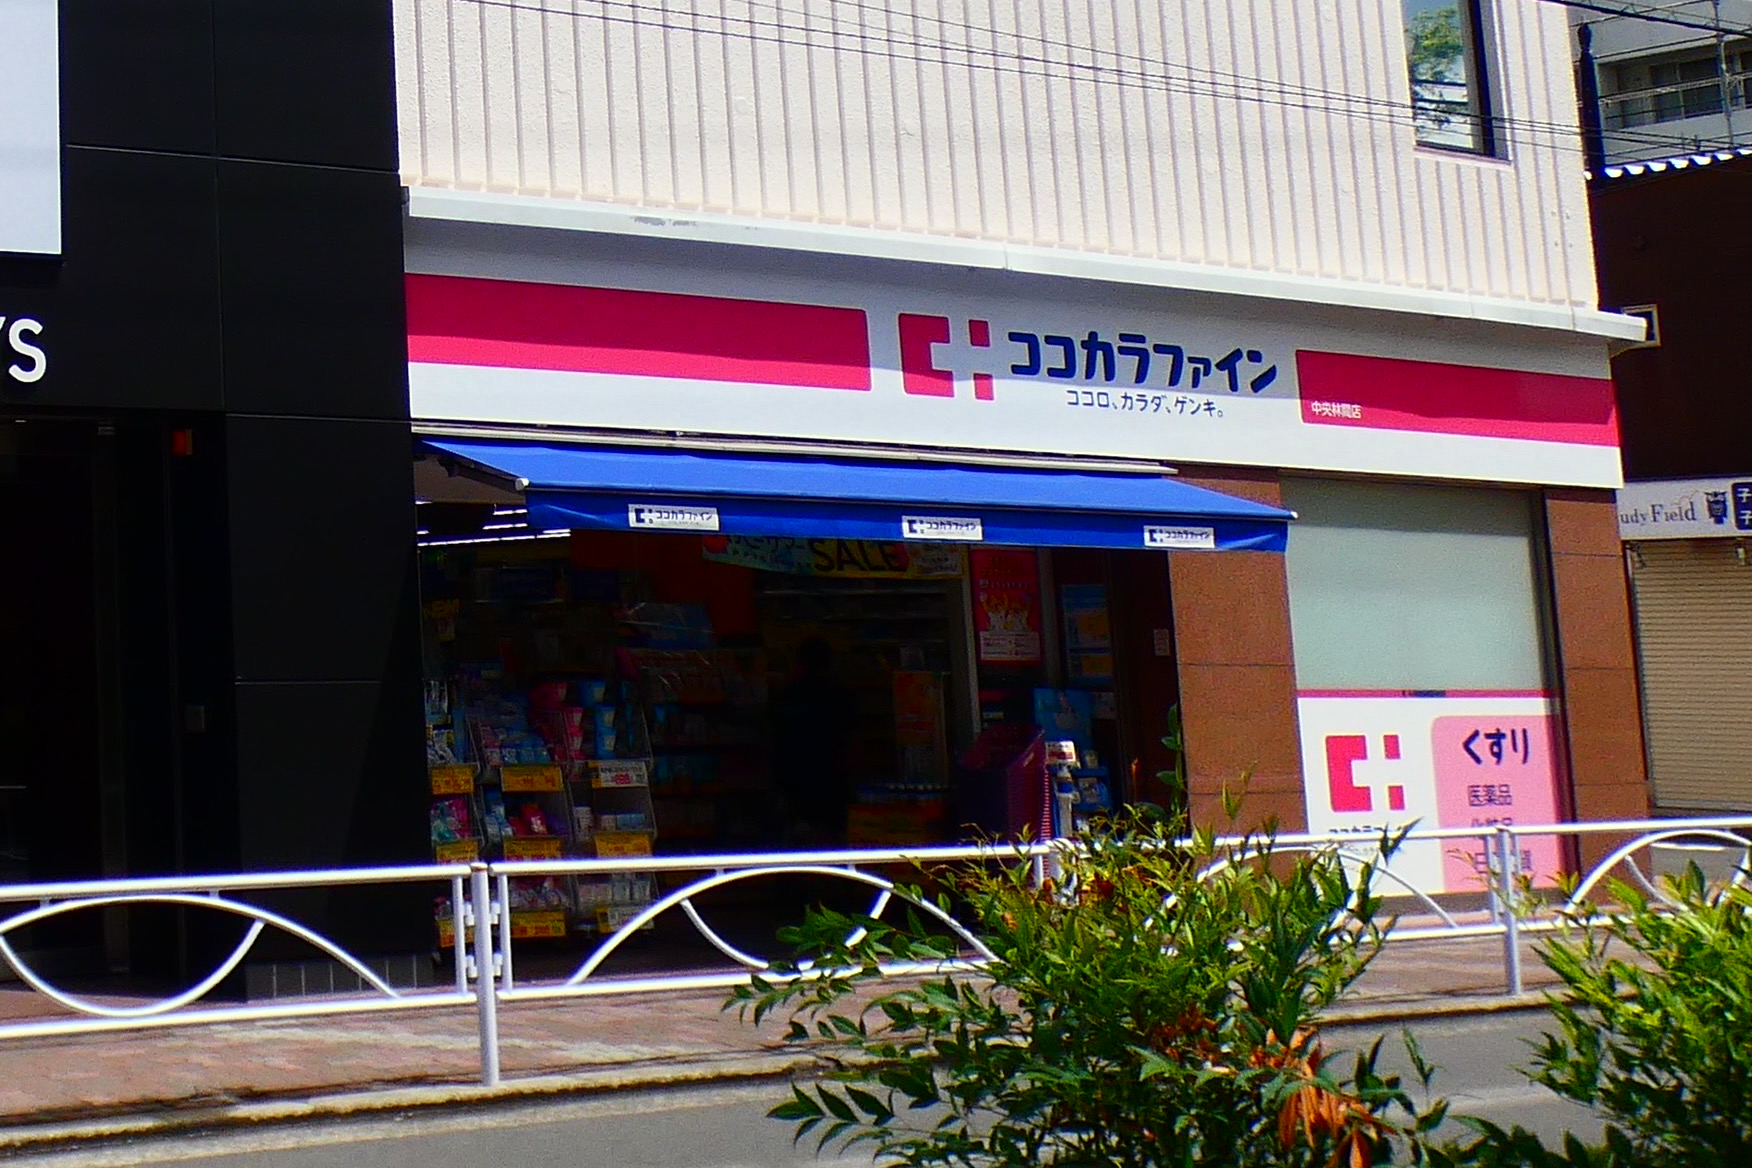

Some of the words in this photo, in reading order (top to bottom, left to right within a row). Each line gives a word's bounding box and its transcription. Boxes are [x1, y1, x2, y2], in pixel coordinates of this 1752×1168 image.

[1007, 331, 1277, 393] ココカラファイン
[1065, 389, 1224, 418] ココロ、カラダ、ゲンキ。
[1619, 508, 1648, 526] udy
[1650, 501, 1697, 523] Field
[1462, 727, 1529, 765] くすり
[1467, 783, 1513, 808] 医薬品
